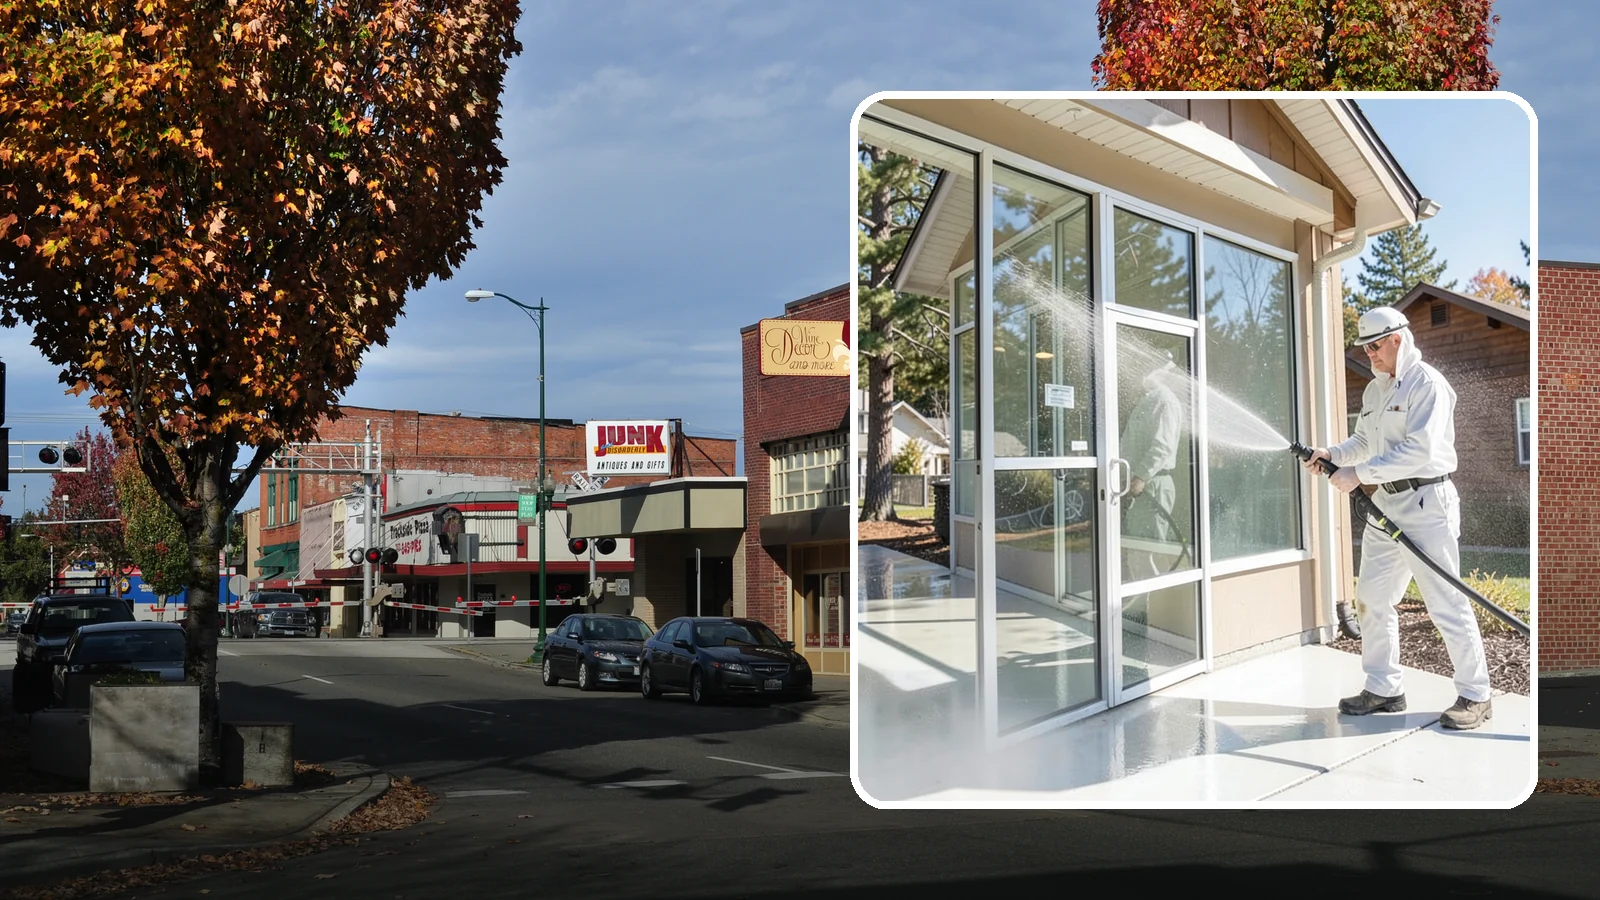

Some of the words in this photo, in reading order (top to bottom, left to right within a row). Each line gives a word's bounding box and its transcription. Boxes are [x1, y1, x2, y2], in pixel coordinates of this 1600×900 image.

[595, 425, 665, 457] JUNK
[607, 446, 646, 454] DISORDERLY
[597, 461, 628, 470] ANTIQUES
[631, 461, 644, 470] AND
[647, 460, 665, 469] GIFTS
[573, 473, 589, 492] RAIL
[590, 475, 608, 491] SING
[390, 521, 413, 539] Trackside
[414, 520, 429, 534] Pizza
